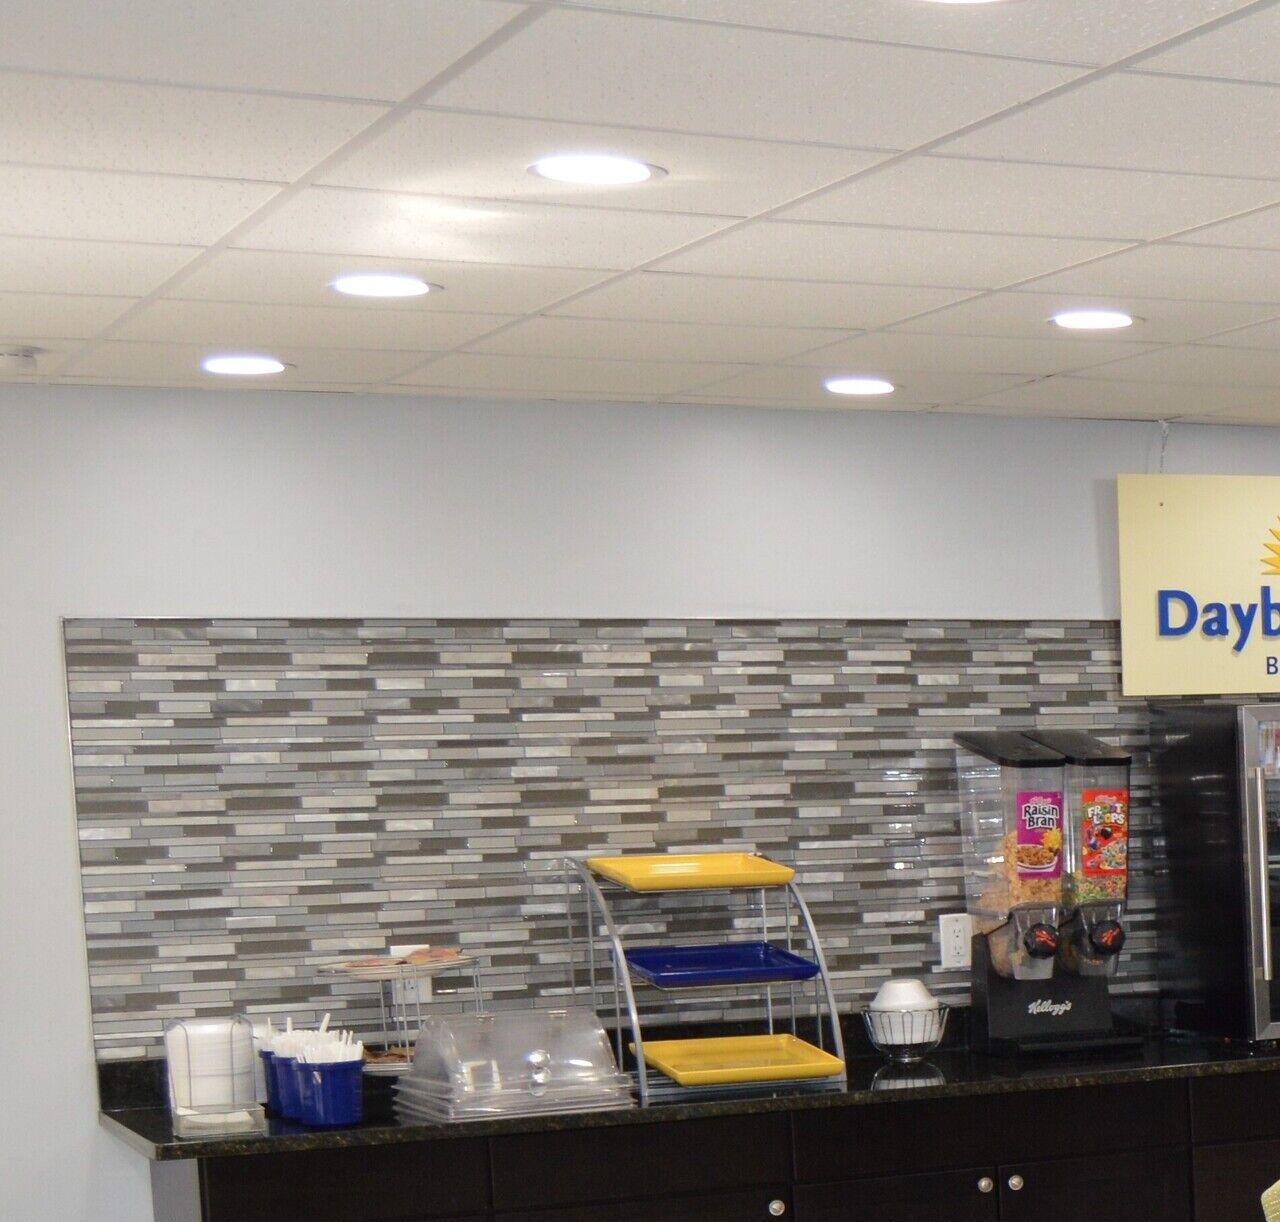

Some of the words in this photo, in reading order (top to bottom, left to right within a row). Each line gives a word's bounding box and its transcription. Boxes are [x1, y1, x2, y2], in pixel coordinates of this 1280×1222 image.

[1023, 805, 1058, 817] Raisin
[1028, 816, 1055, 828] Bran
[1028, 1000, 1072, 1016] Kellogg's
